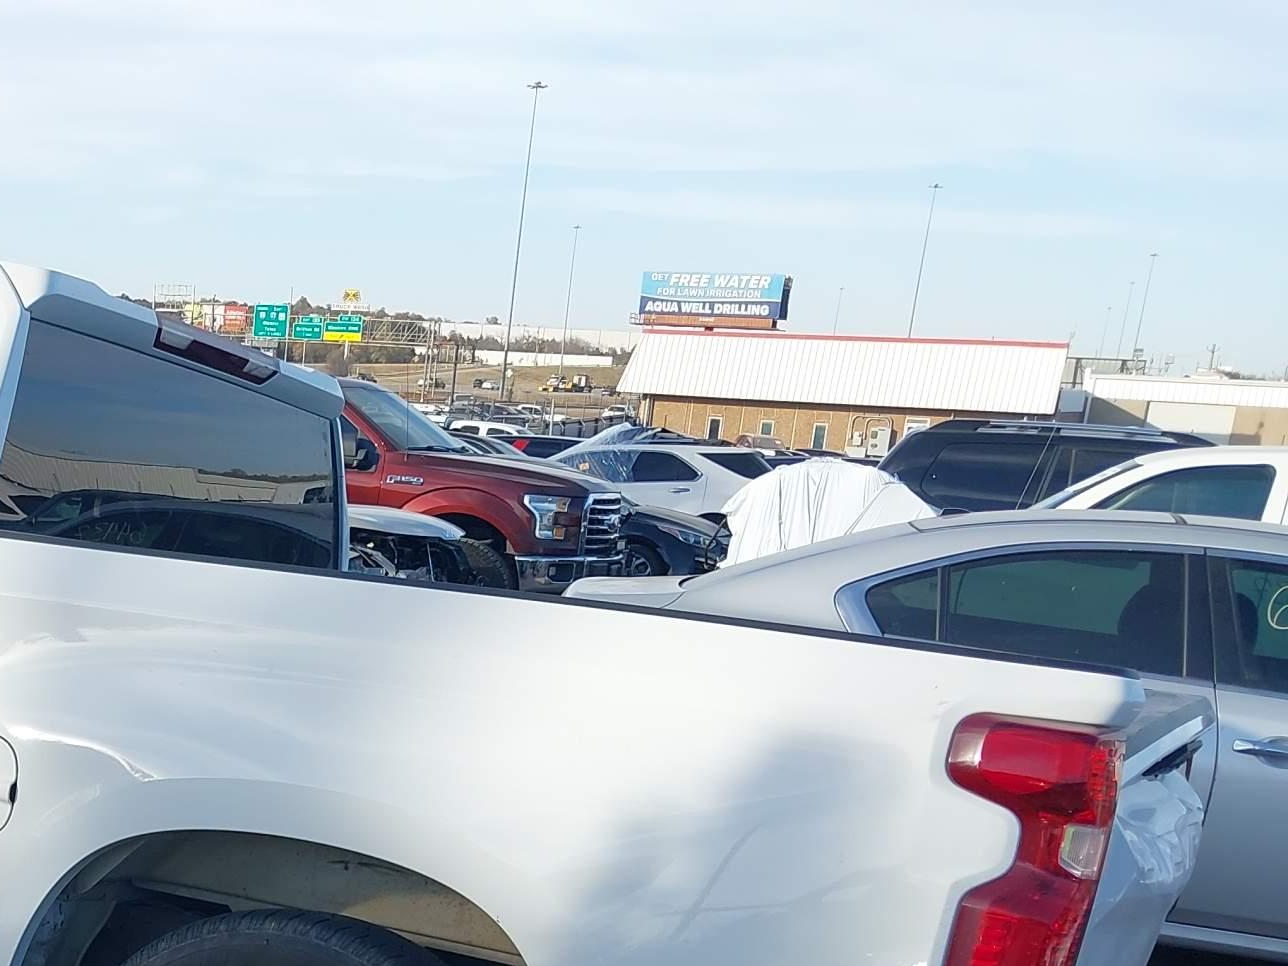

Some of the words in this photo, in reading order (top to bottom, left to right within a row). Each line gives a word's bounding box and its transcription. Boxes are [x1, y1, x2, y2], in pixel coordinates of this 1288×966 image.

[651, 272, 669, 281] GET
[669, 273, 710, 287] FREE
[714, 275, 772, 289] WATER
[656, 287, 675, 296] FOR
[677, 288, 704, 298] LAWN
[705, 288, 762, 299] IRRIGATION
[644, 301, 679, 313] AQUA
[680, 302, 712, 314] WELL
[713, 303, 771, 316] DRILLING
